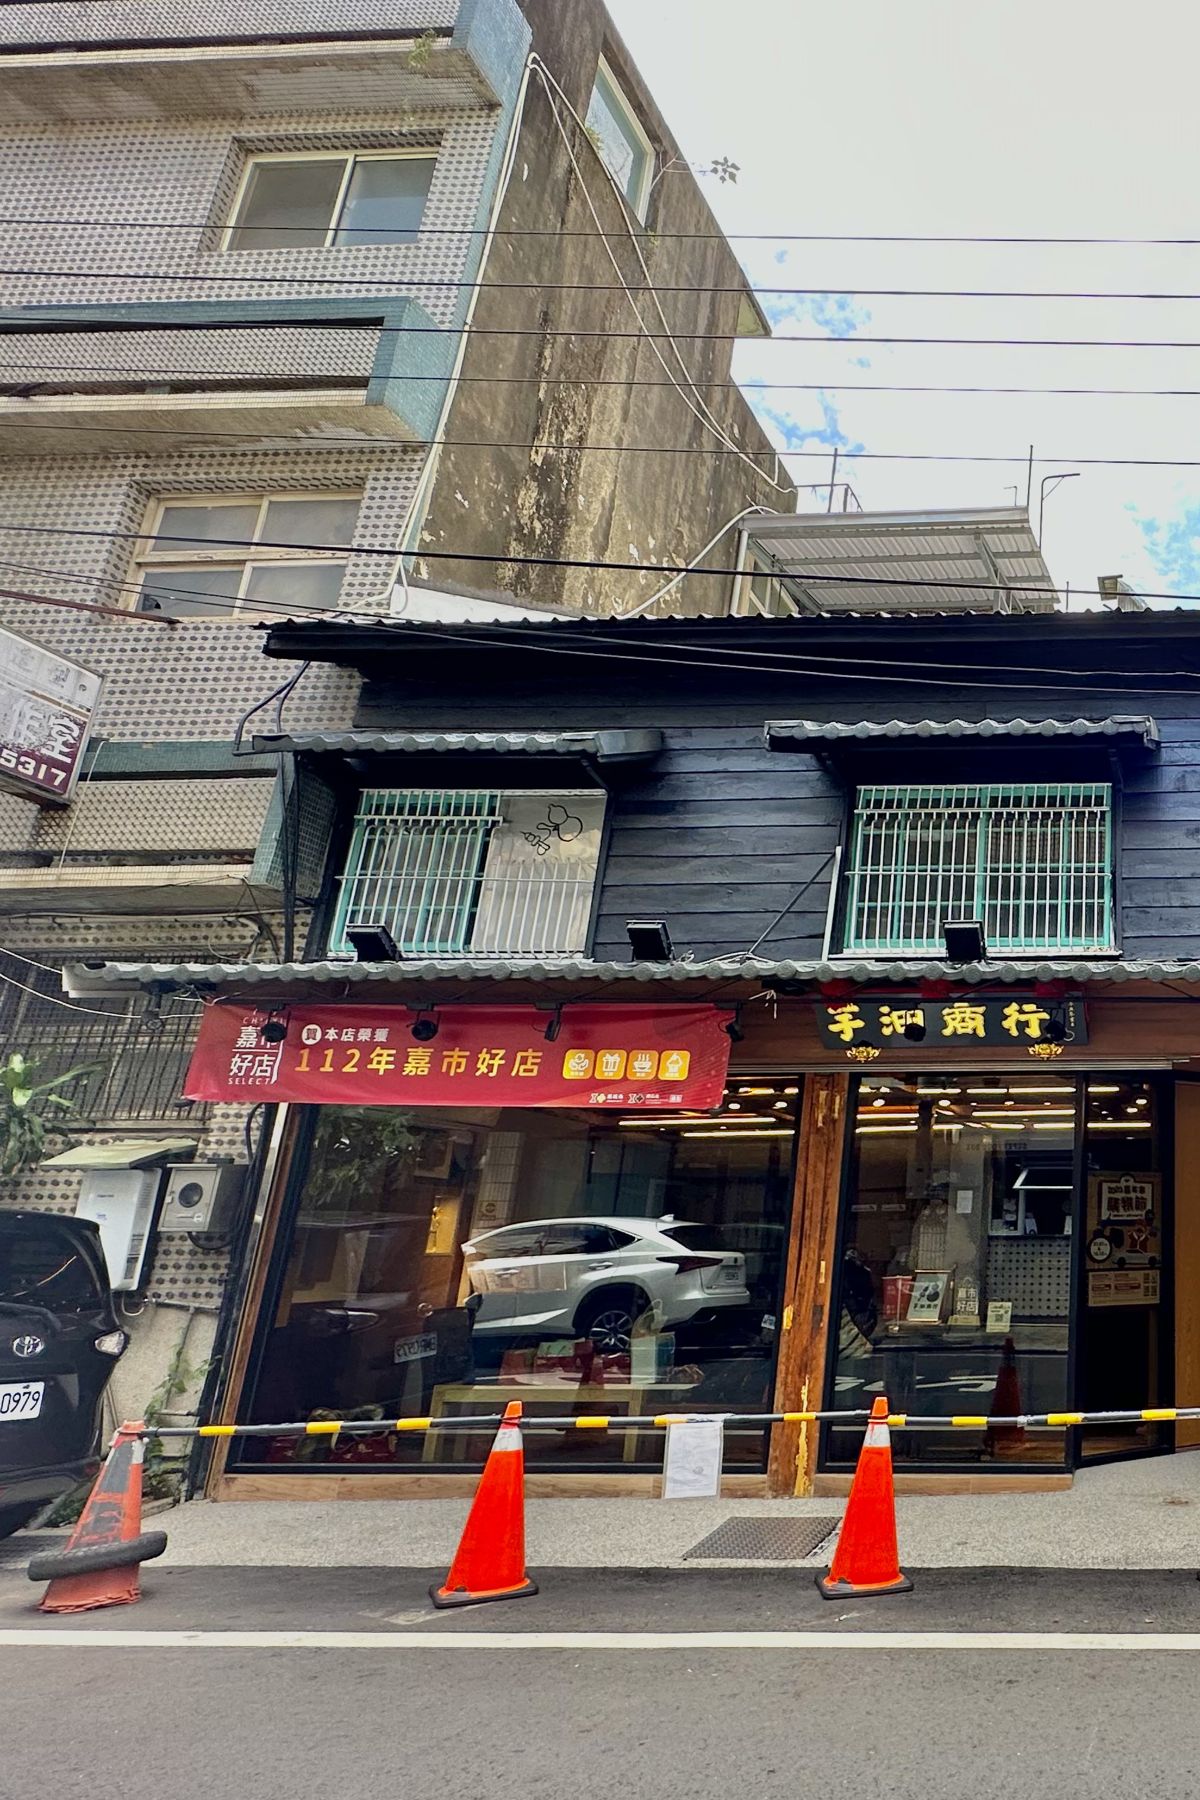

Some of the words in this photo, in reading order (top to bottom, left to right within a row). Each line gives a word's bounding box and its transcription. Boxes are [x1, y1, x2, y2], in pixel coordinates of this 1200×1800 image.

[0, 748, 67, 786] 5317
[324, 1027, 390, 1042] 本店榮獲
[229, 1053, 276, 1076] 好店
[294, 1046, 543, 1077] 112年嘉市好店
[228, 1077, 272, 1085] SELECT
[0, 1390, 41, 1414] 0979
